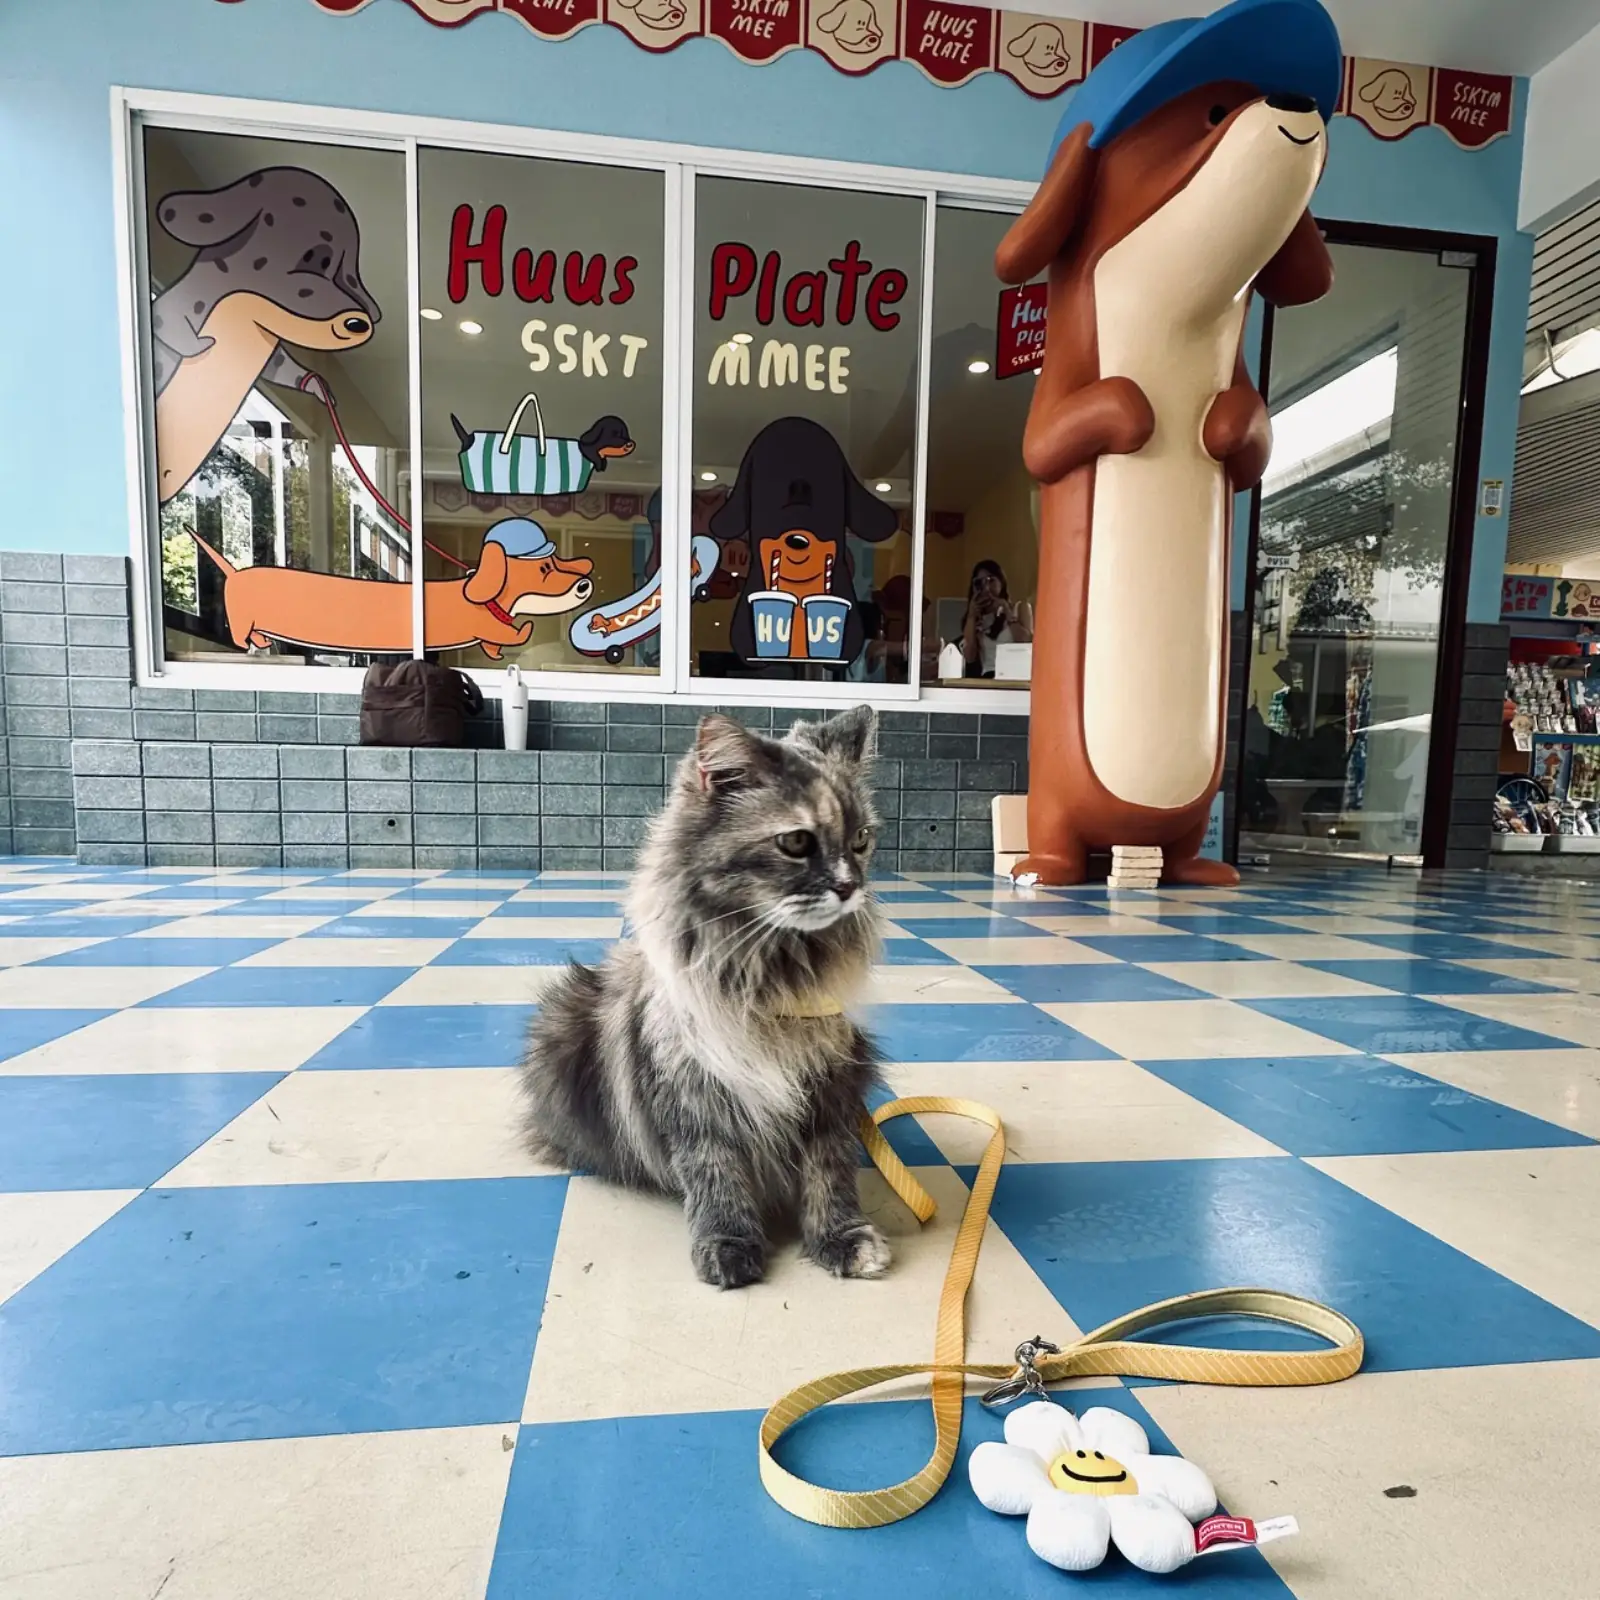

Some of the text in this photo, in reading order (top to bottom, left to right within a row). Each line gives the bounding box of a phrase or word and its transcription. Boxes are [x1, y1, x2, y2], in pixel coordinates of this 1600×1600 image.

[729, 14, 776, 39] MEE
[922, 10, 978, 39] HUUS
[919, 33, 974, 64] PLATE
[1453, 81, 1502, 108] SSKTM
[1450, 105, 1489, 127] MEE
[447, 204, 909, 332] Huus Plate
[1016, 328, 1047, 347] Pla
